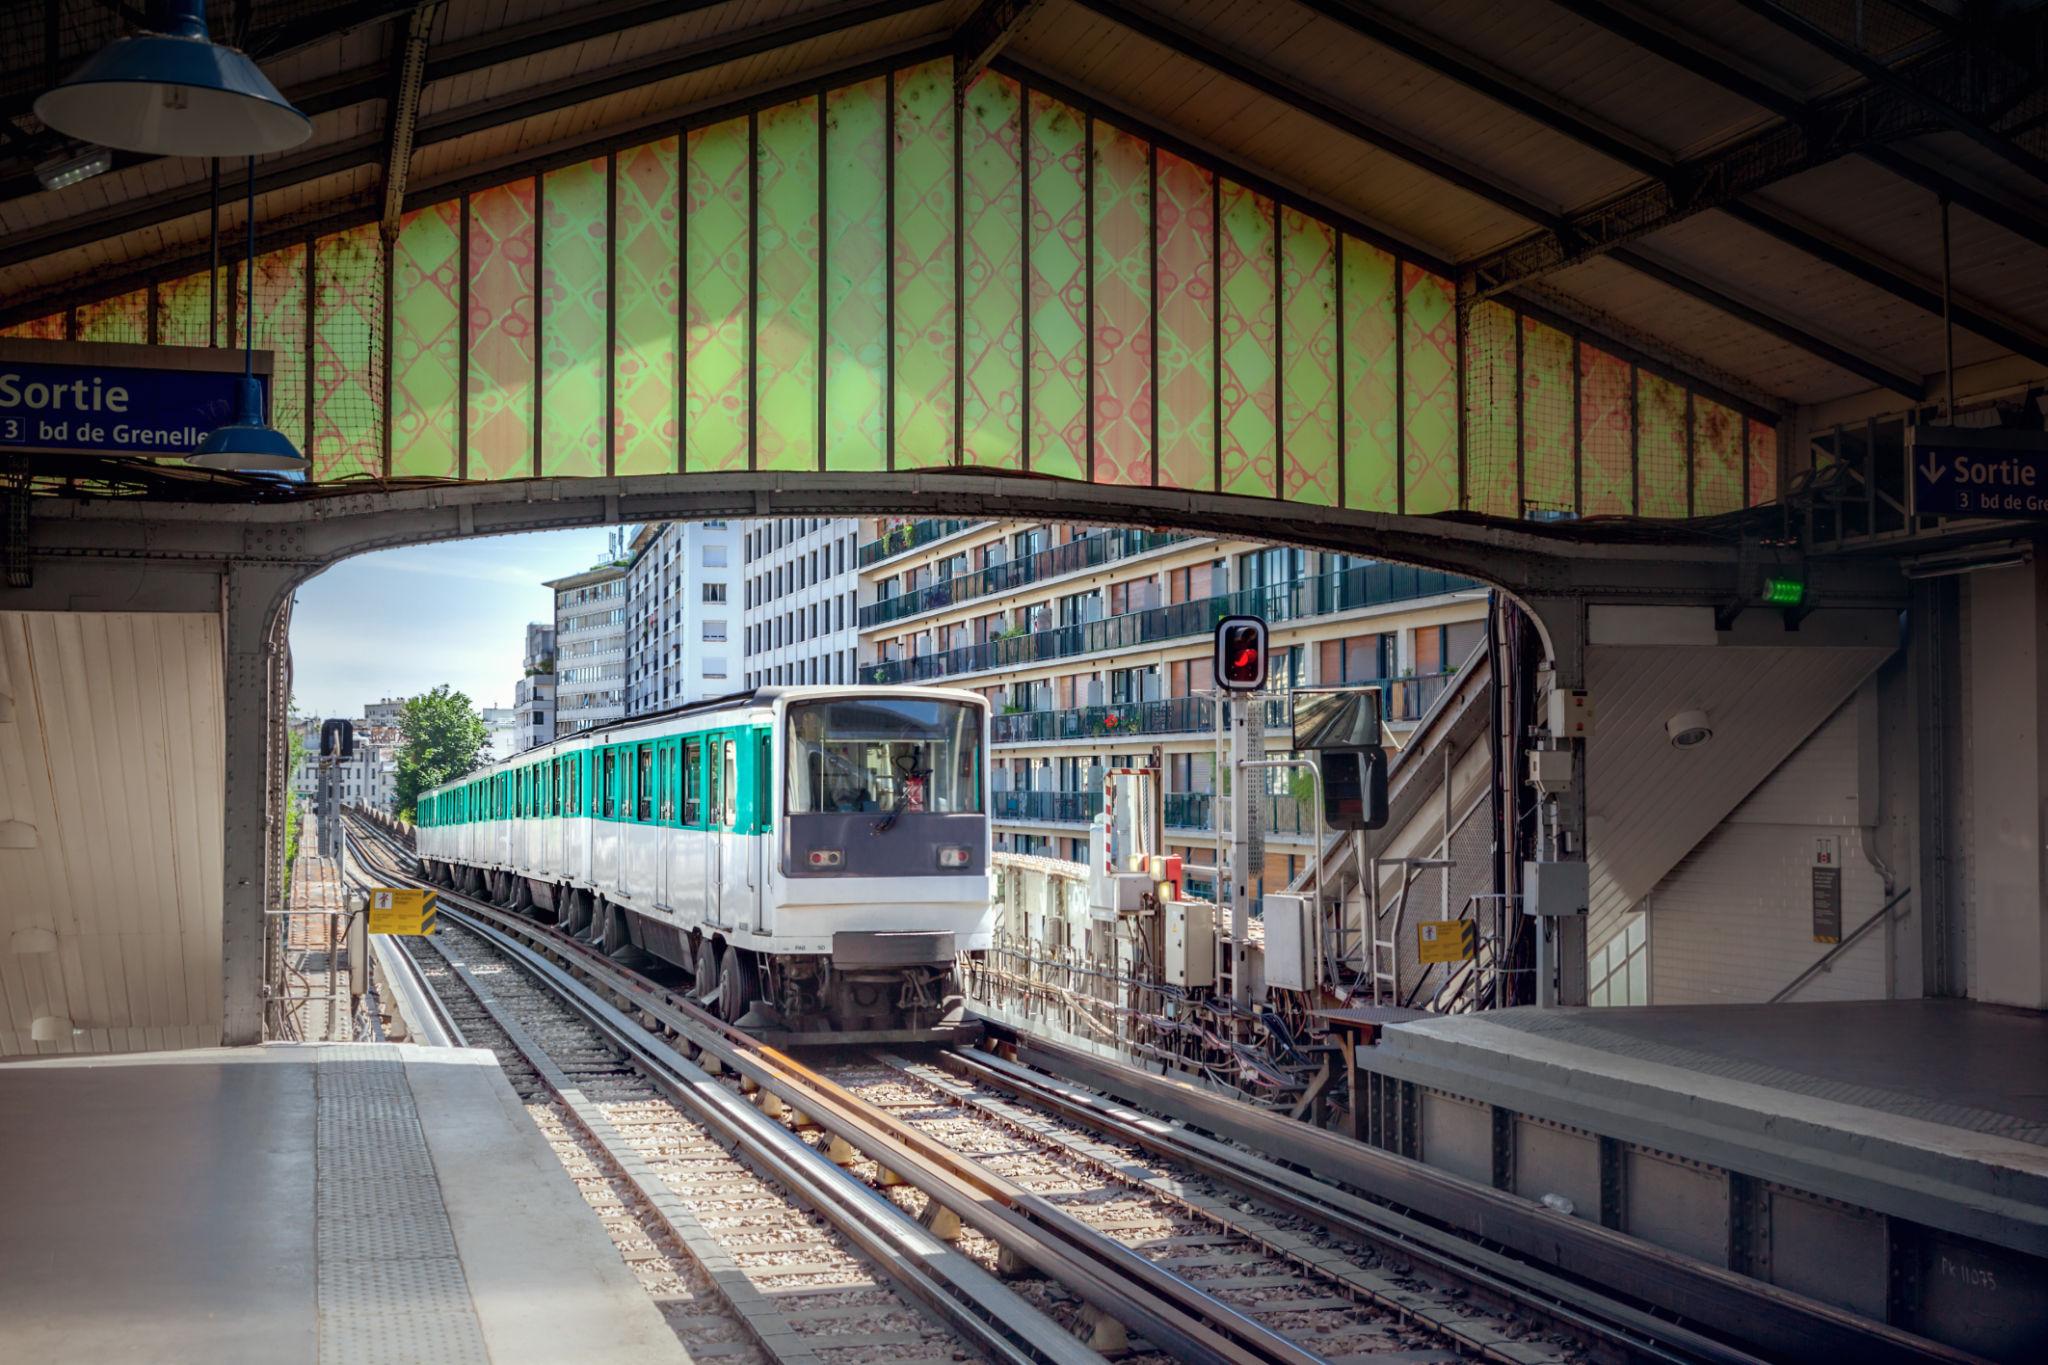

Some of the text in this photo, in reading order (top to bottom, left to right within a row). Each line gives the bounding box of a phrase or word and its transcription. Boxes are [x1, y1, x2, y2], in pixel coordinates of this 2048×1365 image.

[0, 373, 129, 413] Sortie
[4, 419, 19, 439] 3
[39, 420, 69, 441] bd
[75, 422, 105, 443] de
[1953, 455, 2037, 487] Sortie
[1959, 492, 1969, 508] 3
[1980, 493, 2000, 509] bd
[2003, 494, 2022, 510] de
